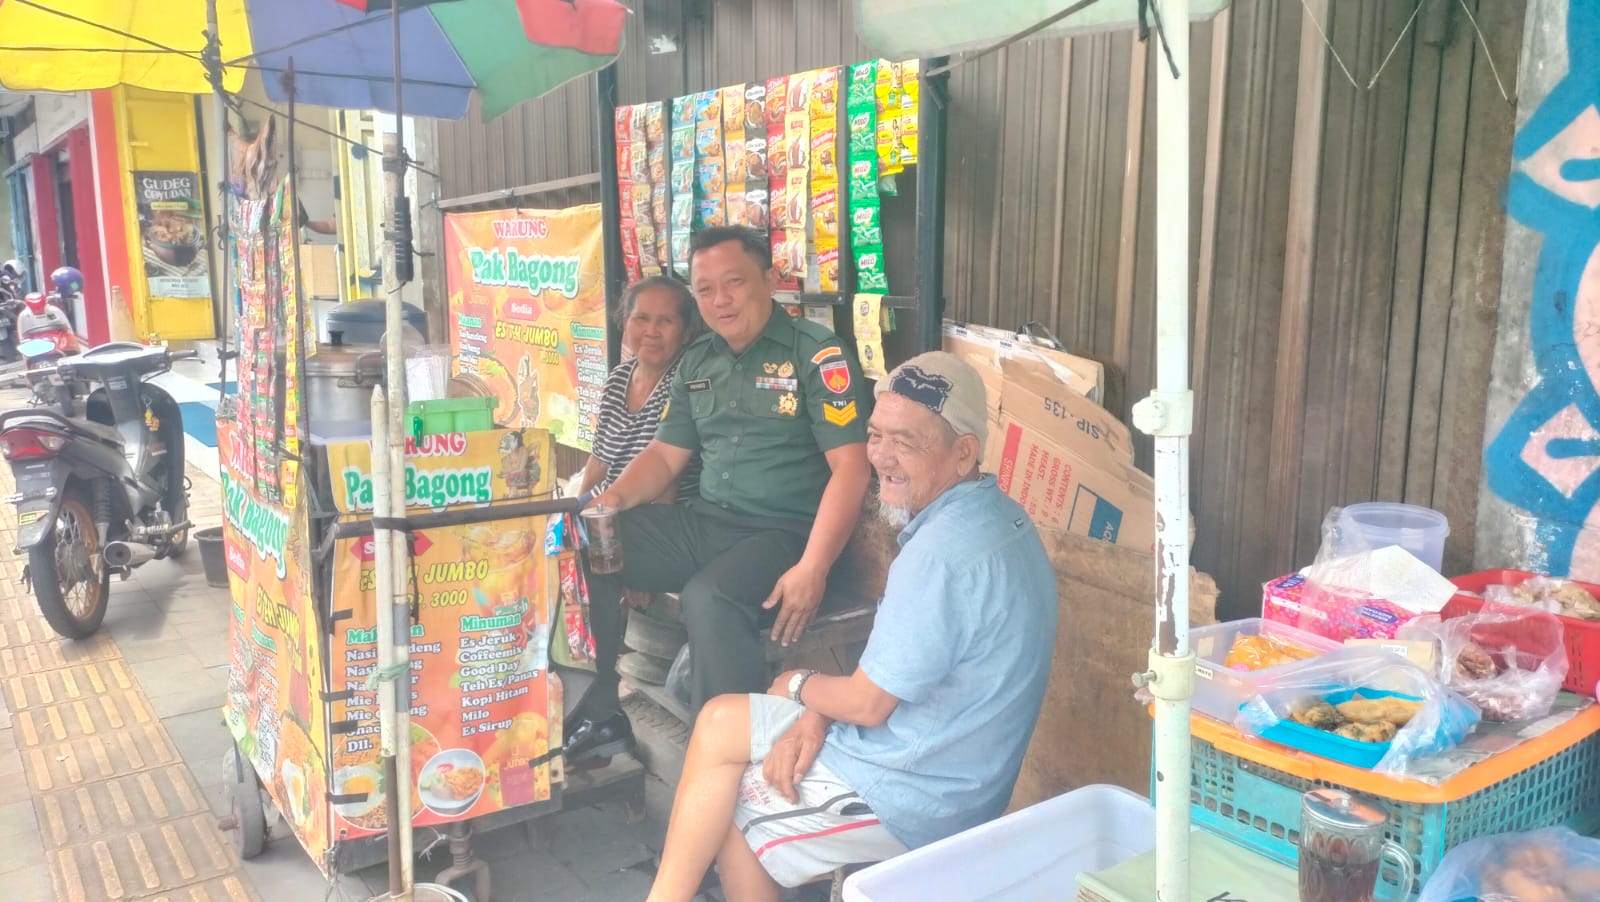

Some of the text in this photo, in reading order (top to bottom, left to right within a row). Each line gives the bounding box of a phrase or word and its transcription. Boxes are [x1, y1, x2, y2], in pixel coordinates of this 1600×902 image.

[142, 177, 191, 191] GUDEG
[494, 221, 547, 238] WARUNG
[858, 256, 875, 267] MILO
[470, 249, 578, 292] Pak Bagong
[511, 303, 533, 315] Sedia
[495, 320, 506, 339] ES
[523, 325, 558, 349] JUMBO
[833, 400, 847, 408] TNI
[1044, 397, 1067, 420] 135
[1076, 419, 1100, 440] SIP
[1028, 444, 1039, 468] MADE
[1048, 457, 1061, 488] GROSS
[344, 466, 490, 507] Pa Bagong
[1055, 464, 1071, 511] CONTENTS
[423, 559, 489, 585] JUMBO
[431, 590, 467, 608] 3000
[461, 614, 521, 631] Minuman
[460, 633, 517, 648] Es Jeruk
[346, 648, 377, 662] Nasi
[460, 646, 522, 662] Coffeemix
[461, 661, 519, 677] Good Day
[461, 680, 485, 692] Teh
[346, 695, 372, 708] Mie
[462, 686, 529, 708] Kopi Hitam
[346, 709, 373, 721] Mie
[462, 709, 490, 722] Milo
[462, 719, 513, 737] Es Sirup
